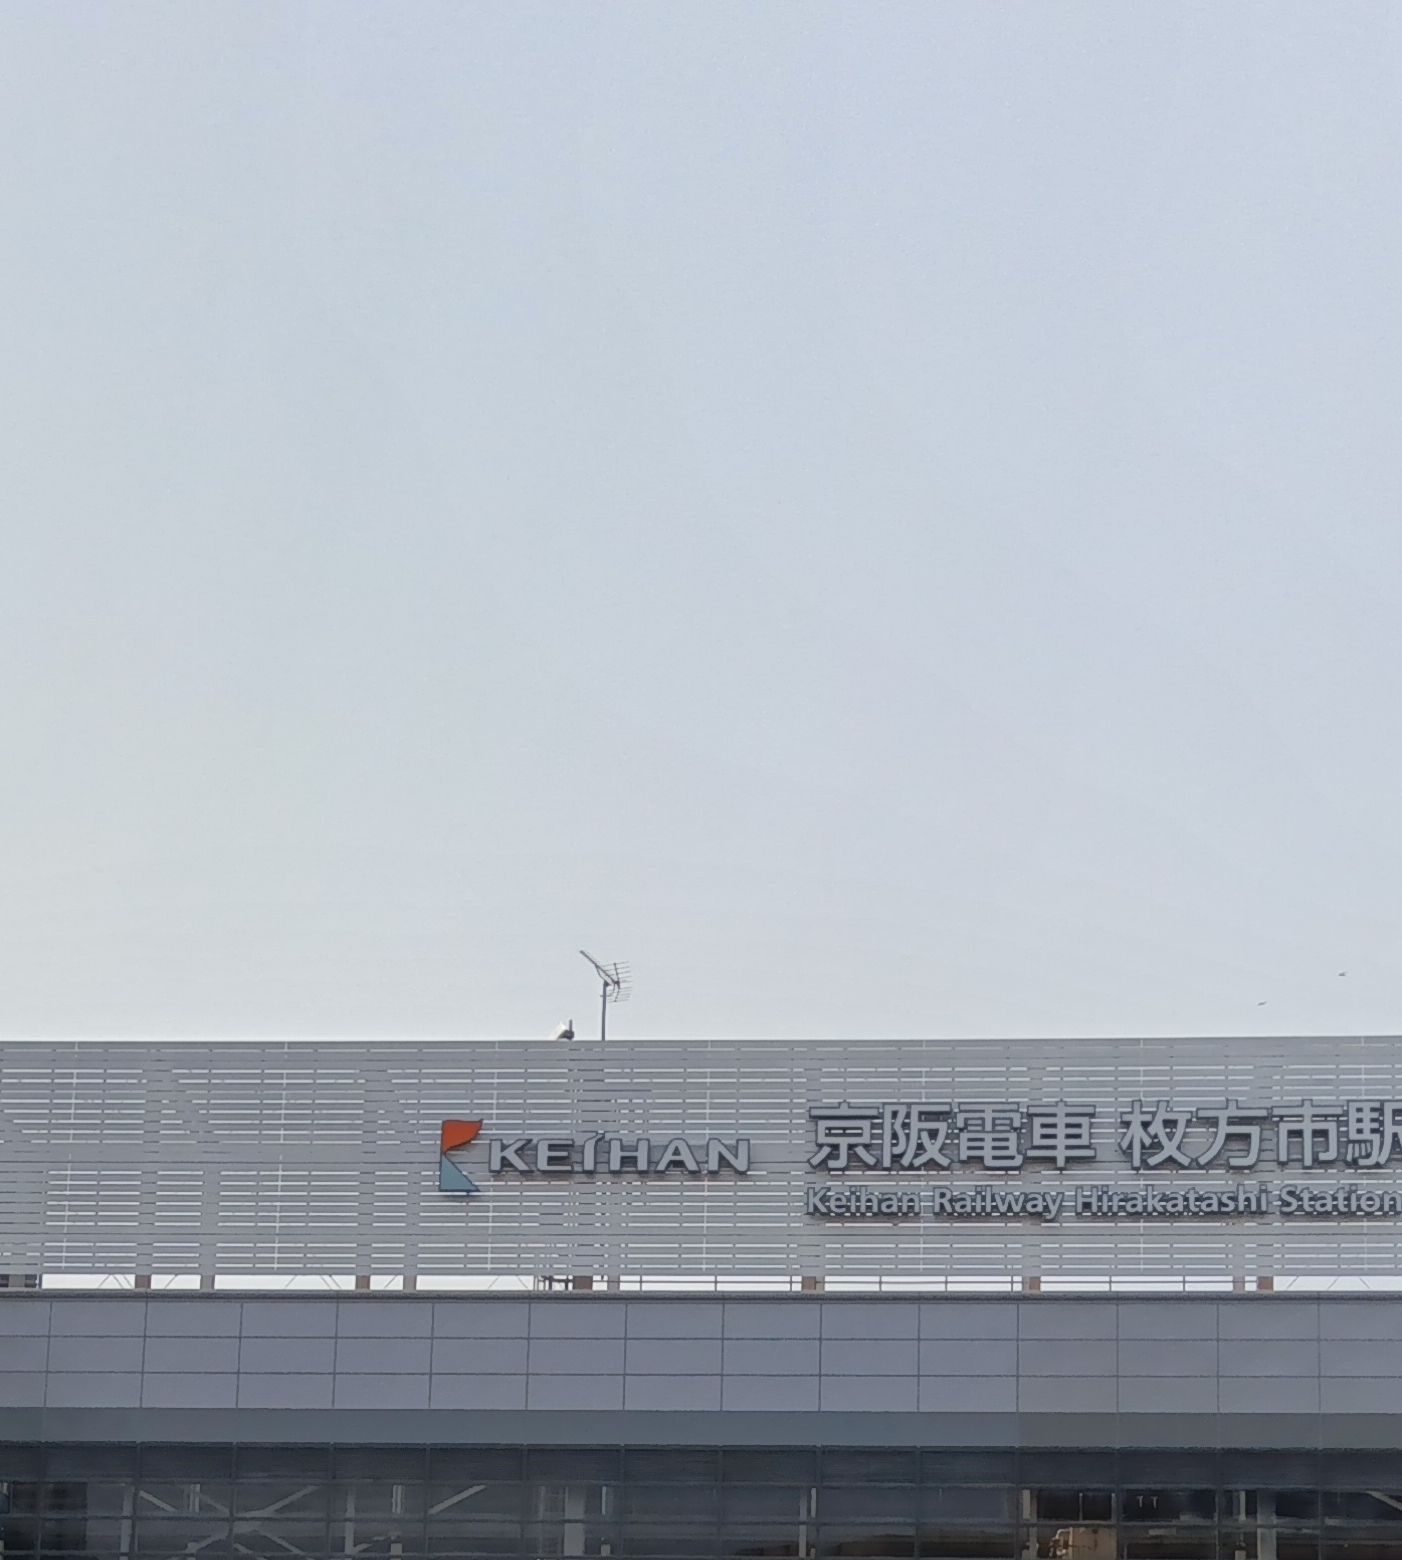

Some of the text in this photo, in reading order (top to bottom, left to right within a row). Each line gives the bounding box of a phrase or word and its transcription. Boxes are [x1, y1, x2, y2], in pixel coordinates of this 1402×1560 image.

[489, 1132, 750, 1173] KEIHAN
[807, 1100, 1097, 1168] 京阪電車
[807, 1185, 921, 1214] Keihan
[933, 1185, 1063, 1220] Railway
[1076, 1184, 1268, 1214] Hirakatashi
